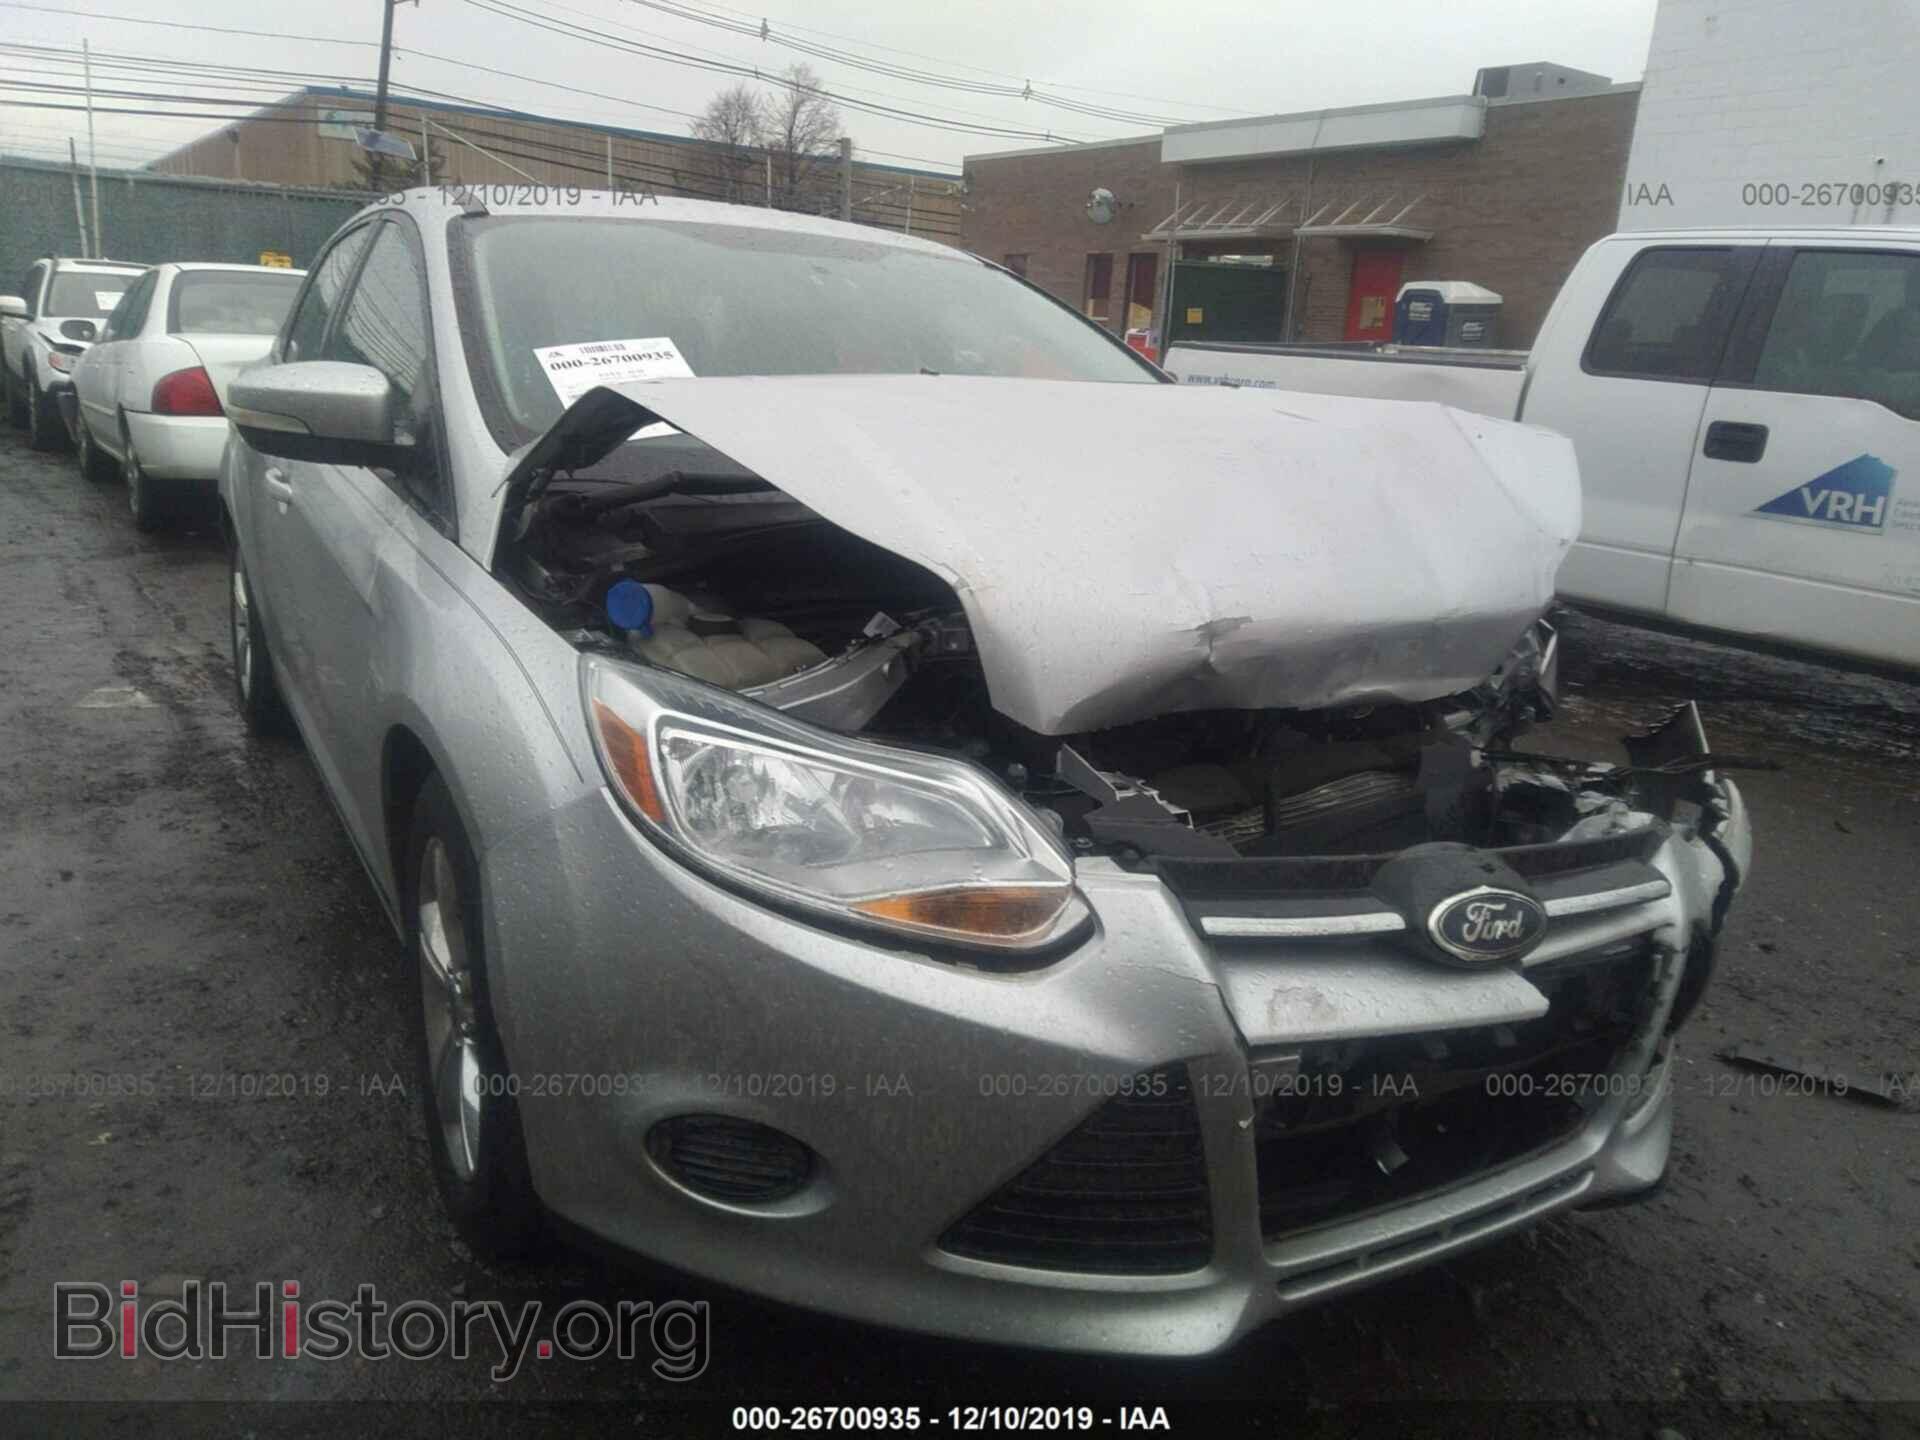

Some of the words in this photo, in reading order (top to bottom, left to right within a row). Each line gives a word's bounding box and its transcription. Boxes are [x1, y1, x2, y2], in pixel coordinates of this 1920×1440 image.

[550, 350, 675, 372] 000-26700935
[1801, 487, 1886, 526] VRH
[1463, 902, 1524, 943] Ford
